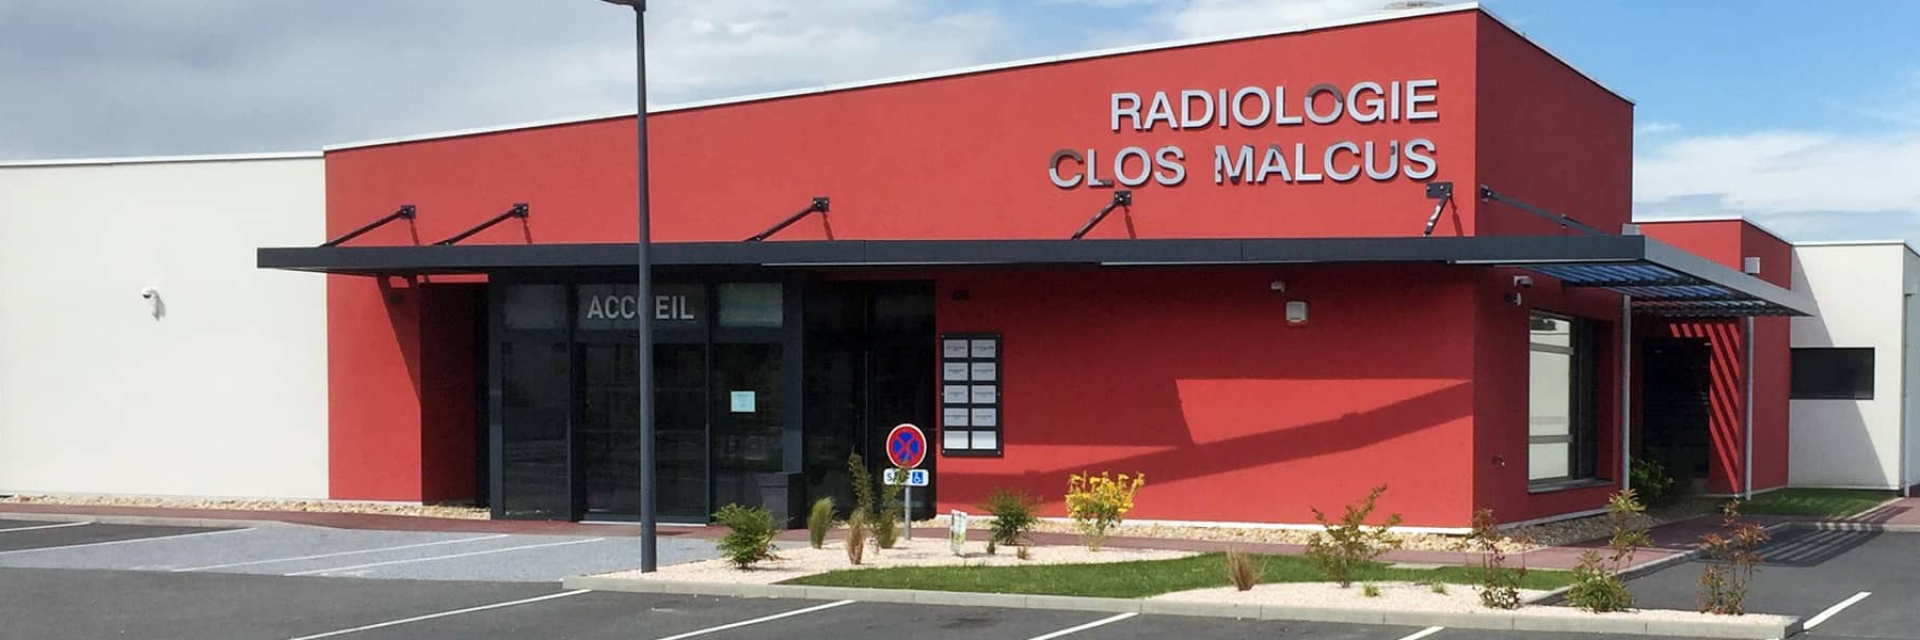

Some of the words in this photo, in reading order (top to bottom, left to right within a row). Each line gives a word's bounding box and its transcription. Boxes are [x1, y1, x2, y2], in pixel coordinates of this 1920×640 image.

[1111, 79, 1438, 131] RADIOLOGIE
[1049, 145, 1186, 188] CLOS
[1215, 138, 1437, 184] MALCUS
[587, 295, 695, 320] ACCEIL
